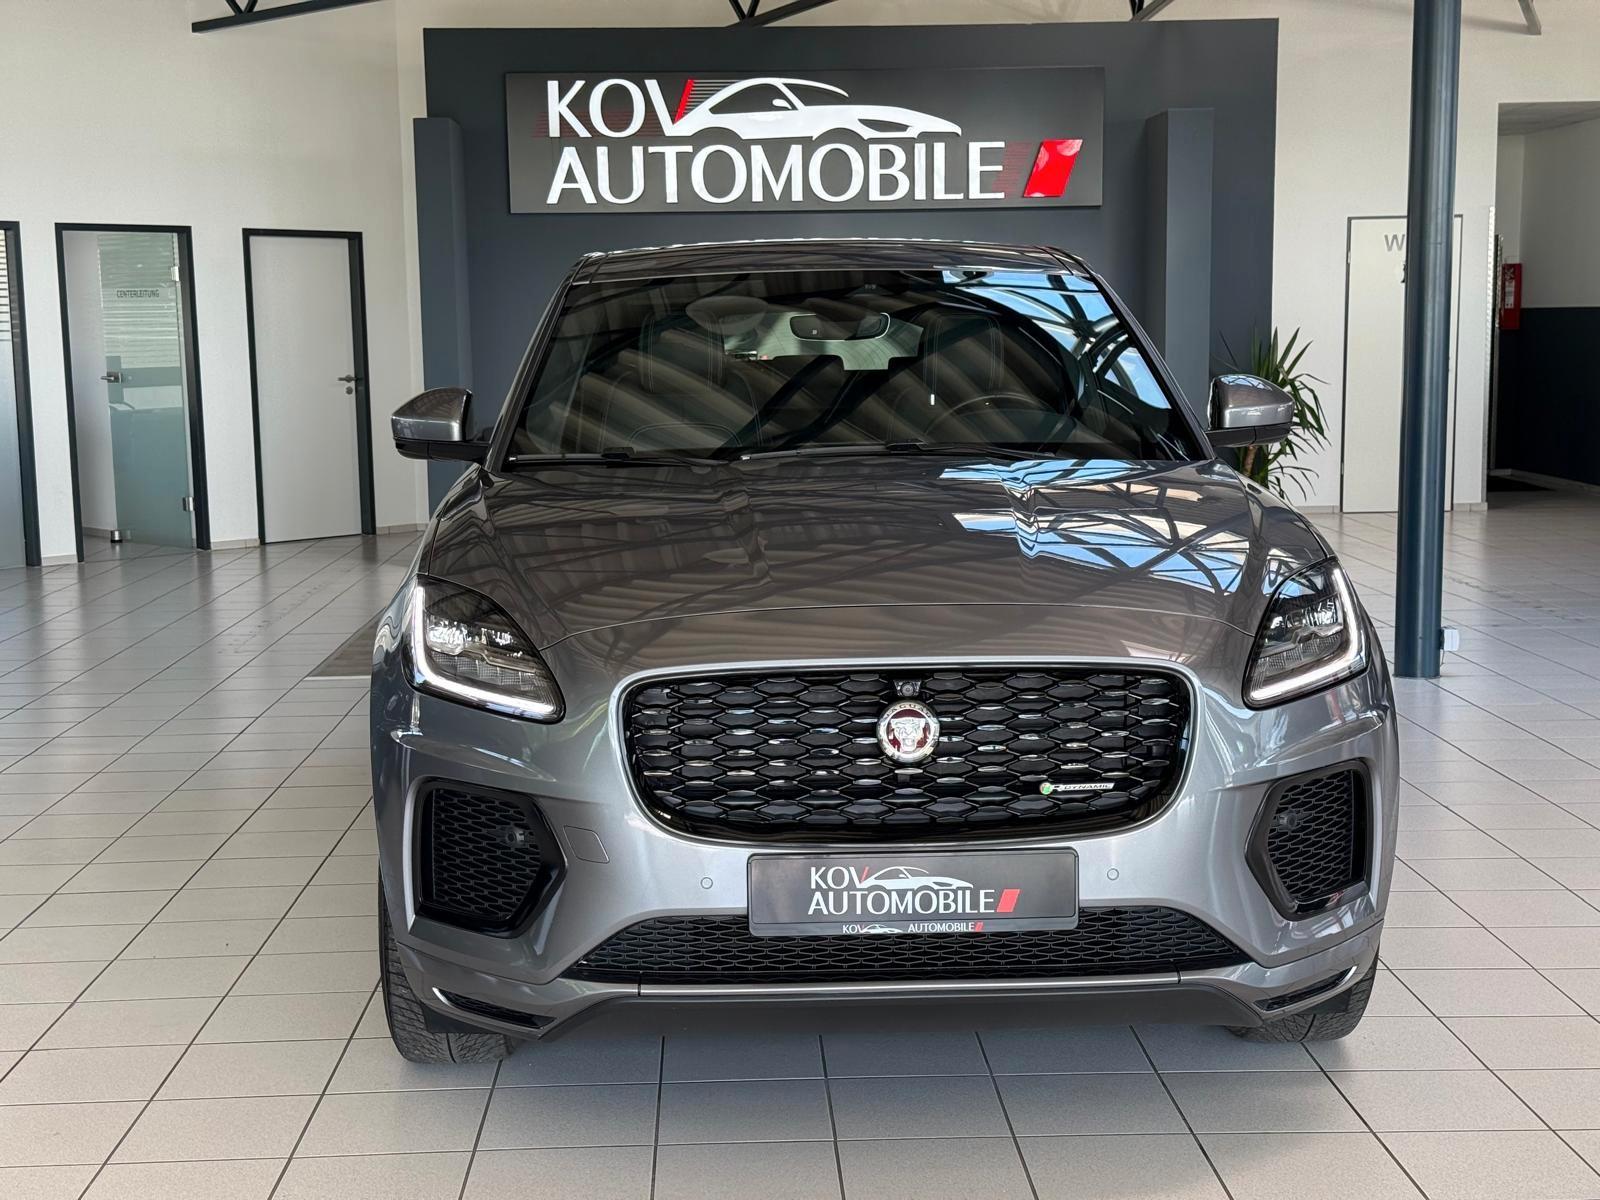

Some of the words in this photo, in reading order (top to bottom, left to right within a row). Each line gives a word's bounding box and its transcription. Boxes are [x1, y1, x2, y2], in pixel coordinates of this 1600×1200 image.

[547, 78, 694, 138] KOV
[545, 140, 1006, 205] AUTOMOBILE
[1384, 233, 1406, 252] W
[116, 288, 160, 298] CENTERLEITUNG
[810, 866, 868, 890] KOV
[807, 889, 996, 915] AUTOMOBILE
[842, 924, 865, 934] KOV
[907, 922, 975, 933] AUTOMOBILE
